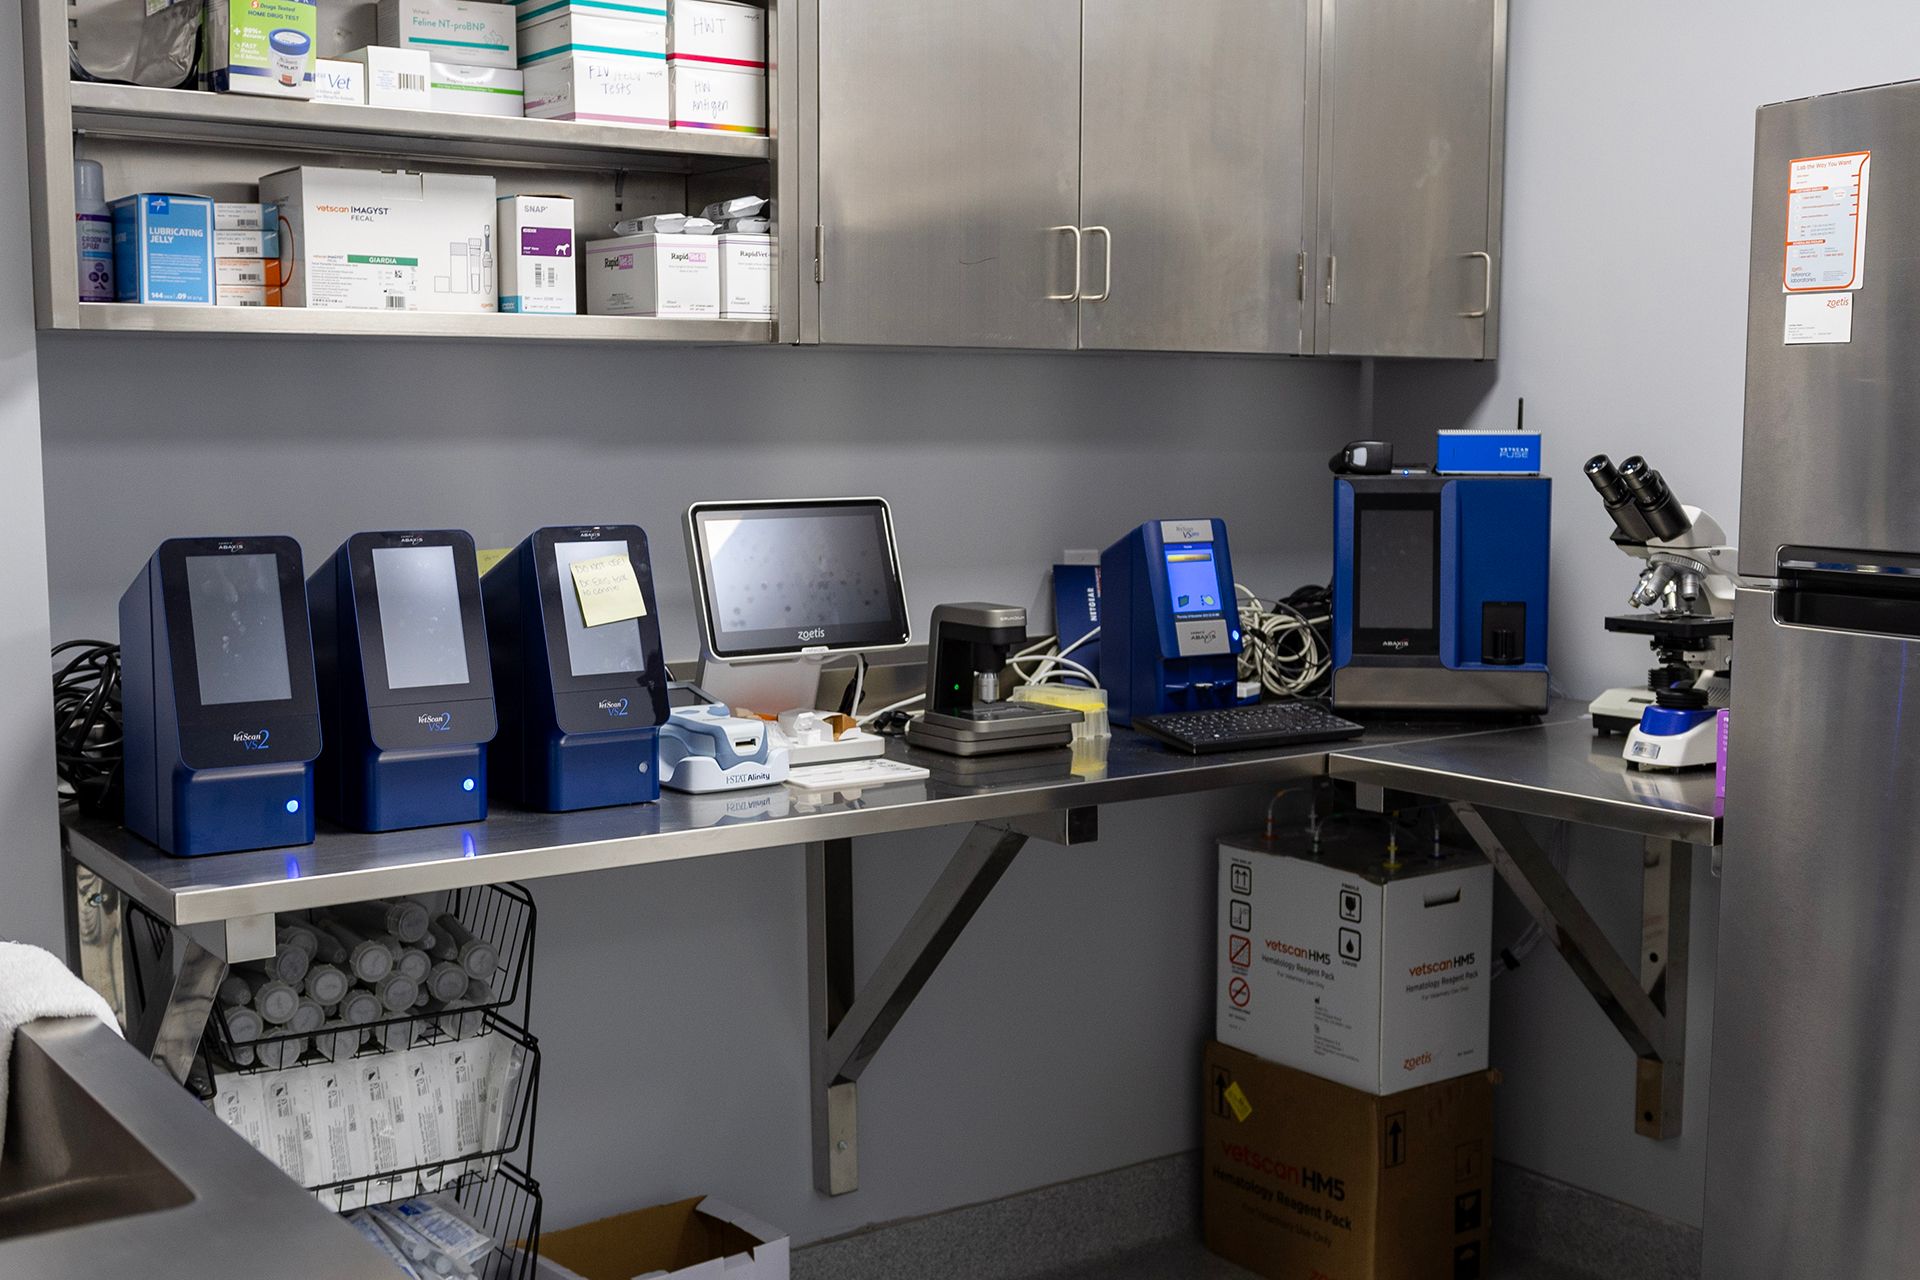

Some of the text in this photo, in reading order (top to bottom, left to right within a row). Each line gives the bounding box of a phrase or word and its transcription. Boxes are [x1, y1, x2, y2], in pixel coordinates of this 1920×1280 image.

[248, 10, 266, 18] HOME
[267, 12, 283, 20] DRUG
[412, 16, 485, 31] Feline NT-proBNP
[328, 74, 351, 89] Vet
[316, 205, 389, 215] vetscan IMAGYST
[149, 227, 203, 237] LUBRICATING
[1826, 297, 1849, 308] zoetis
[797, 627, 825, 640] zoetis
[1191, 634, 1216, 643] ABAXIS
[1382, 640, 1409, 648] ABAXIS
[599, 700, 621, 709] VetScan
[418, 713, 443, 724] VetScan
[233, 731, 261, 742] VetScan
[1265, 939, 1307, 959] vetscan
[1262, 954, 1295, 971] Hematology
[1409, 959, 1452, 976] vetscan
[1406, 980, 1440, 992] Hematology
[1441, 974, 1464, 985] Reagent
[1403, 1051, 1431, 1070] zoetis
[1221, 1140, 1345, 1201] vetscan HM5
[1213, 1166, 1352, 1231] Hematology Reagent Pack
